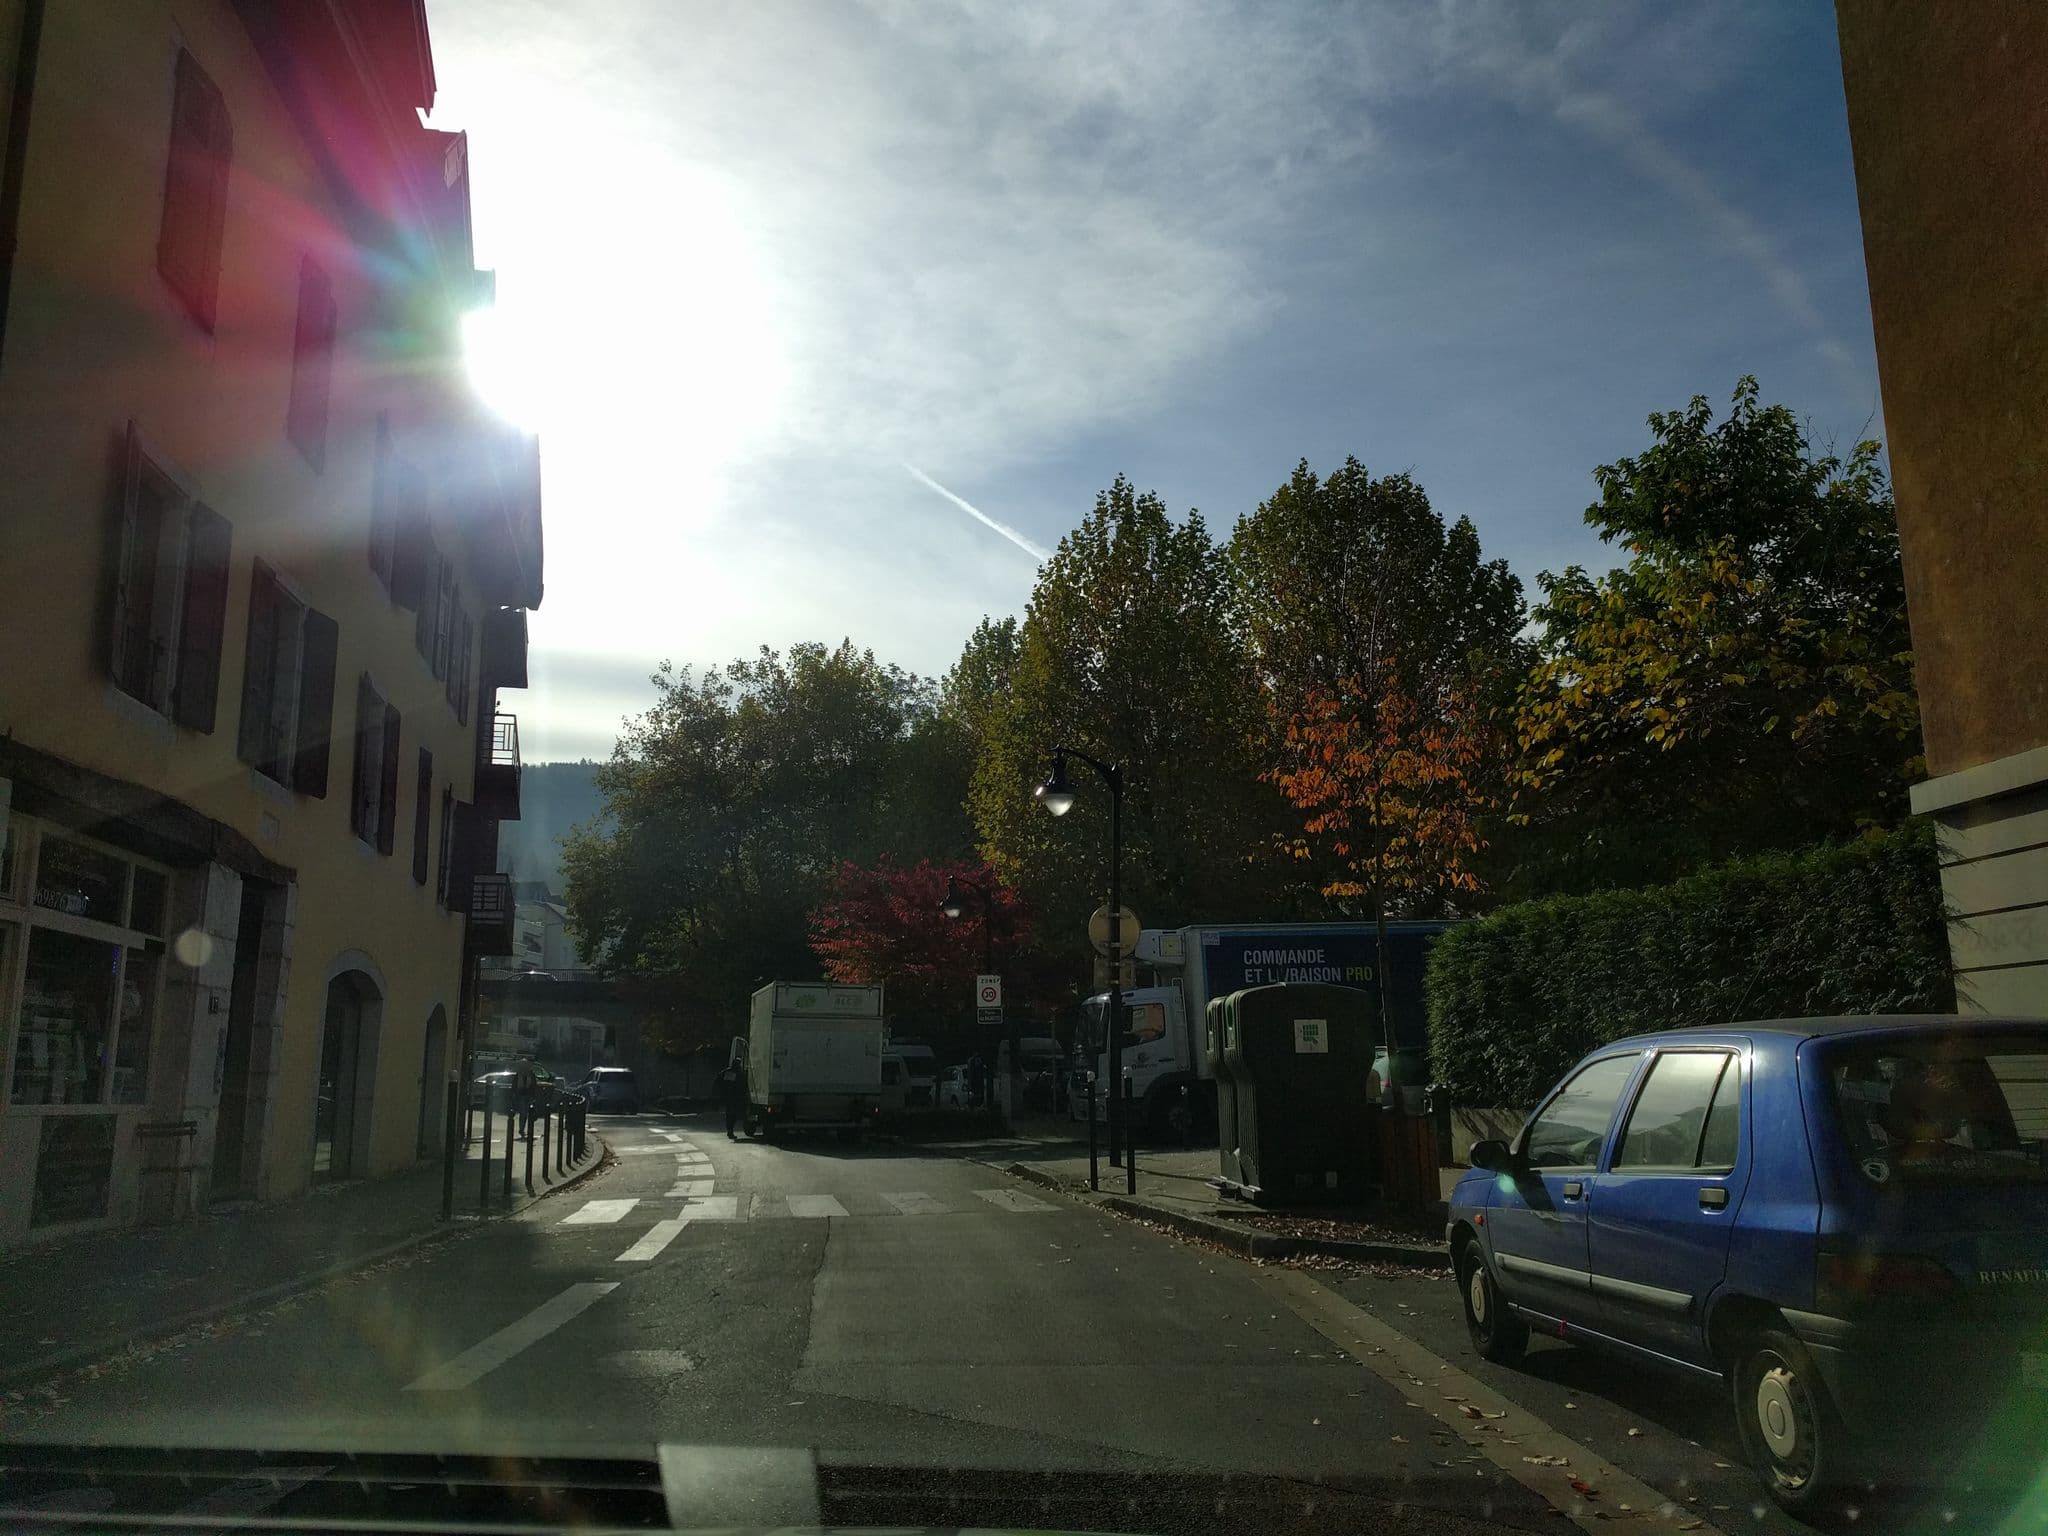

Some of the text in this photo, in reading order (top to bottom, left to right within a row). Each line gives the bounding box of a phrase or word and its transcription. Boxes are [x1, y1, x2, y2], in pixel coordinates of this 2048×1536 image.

[1243, 949, 1327, 966] COMMANDE
[1245, 968, 1263, 984] ET
[1346, 966, 1373, 982] PRO
